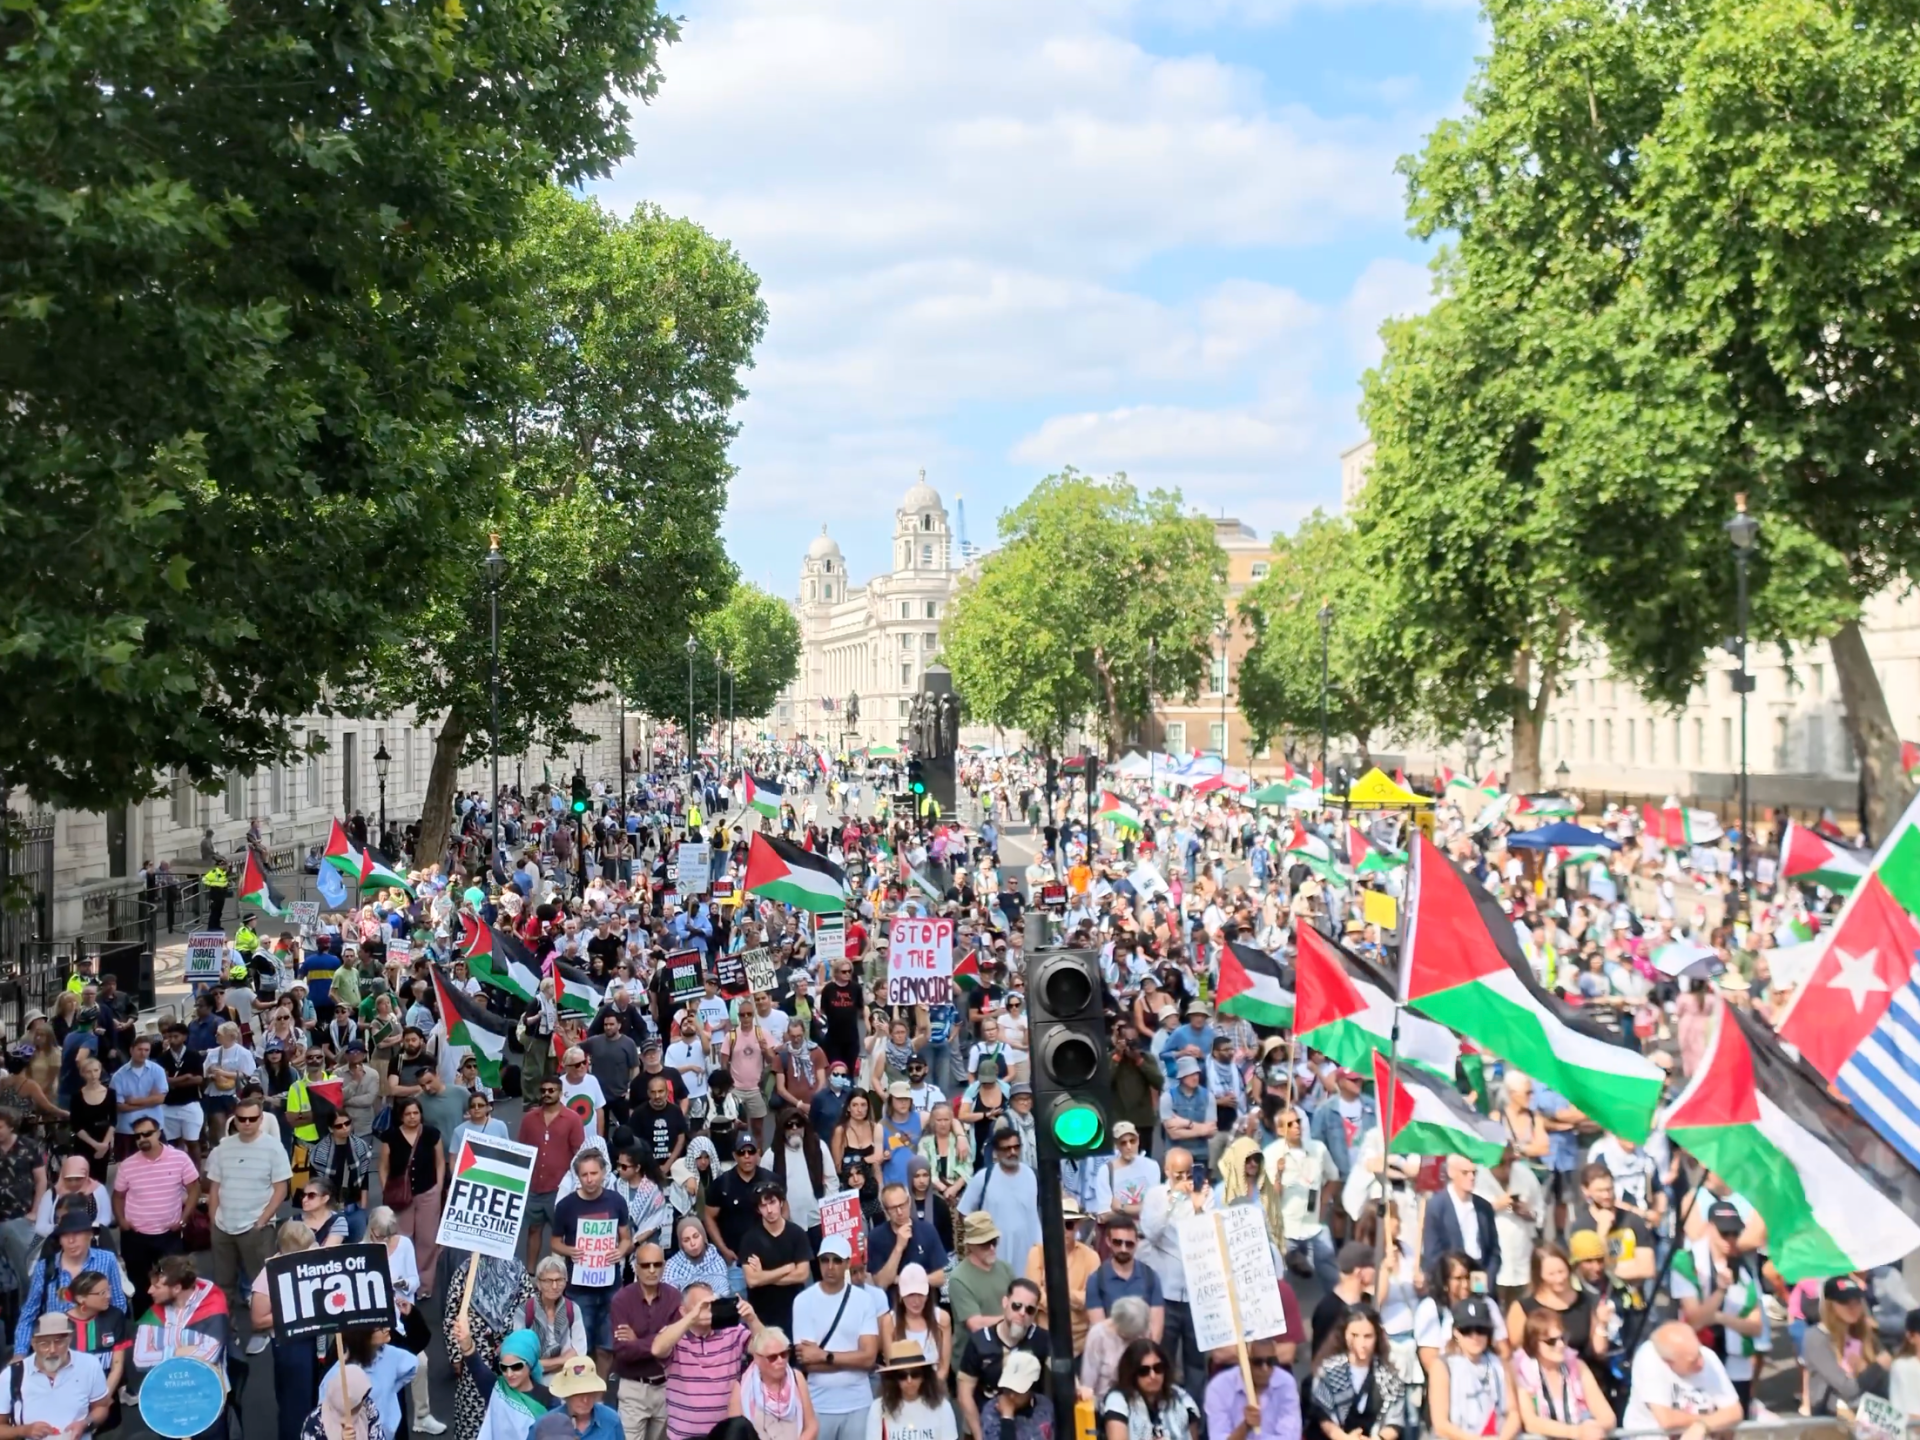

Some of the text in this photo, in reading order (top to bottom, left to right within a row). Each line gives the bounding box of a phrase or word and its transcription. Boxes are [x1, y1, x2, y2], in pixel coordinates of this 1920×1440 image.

[188, 937, 224, 948] SANCTION
[895, 924, 950, 949] STOP
[193, 948, 216, 959] ISRAEL
[907, 949, 936, 969] THE
[191, 959, 215, 971] NOW!
[672, 964, 697, 980] ISRAEL
[748, 960, 772, 976] WILL
[748, 970, 775, 991] YOU?
[889, 974, 953, 1004] GENOCIDE
[450, 1179, 523, 1222] FREE
[822, 1200, 851, 1217] IT'S NOT A
[446, 1207, 518, 1236] PALESTINE
[841, 1210, 850, 1221] TO
[582, 1221, 613, 1236] GAZA
[824, 1223, 836, 1236] ACT
[577, 1237, 615, 1251] CEASE
[296, 1256, 366, 1279] Hands Off
[579, 1253, 611, 1268] FIRE
[1236, 1266, 1276, 1287] PEACE
[277, 1270, 387, 1324] Iran
